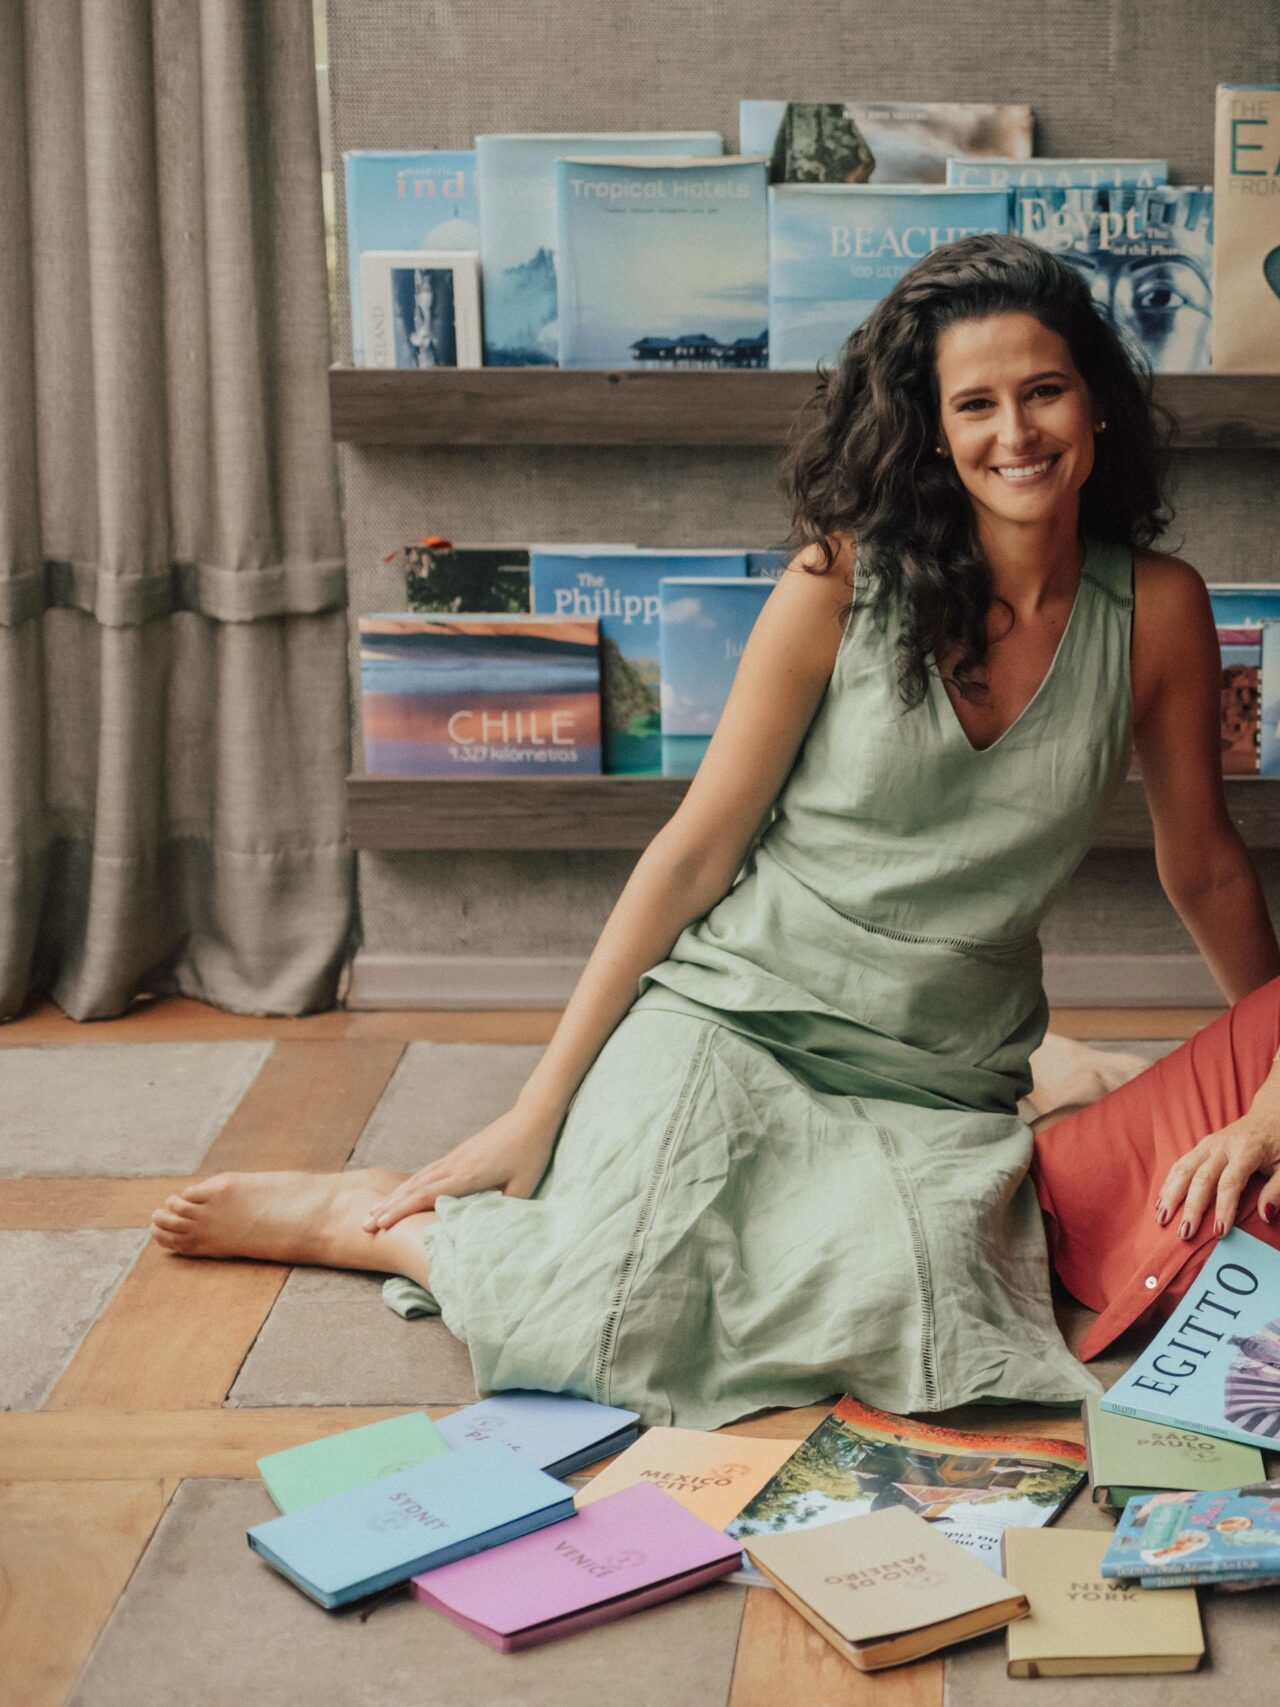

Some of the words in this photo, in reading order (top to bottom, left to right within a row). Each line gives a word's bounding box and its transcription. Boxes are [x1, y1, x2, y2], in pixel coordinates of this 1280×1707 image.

[1231, 99, 1271, 118] THE
[397, 170, 480, 200] indi
[959, 167, 1154, 188] CROATIA
[569, 179, 665, 201] Tropical
[672, 179, 749, 199] Hotels
[1020, 197, 1141, 251] Egypt
[831, 225, 1000, 258] BEACH
[372, 306, 387, 367] CELAND
[577, 572, 606, 588] The
[554, 589, 661, 625] Philipp
[447, 710, 577, 745] CHILE
[1130, 1262, 1259, 1397] EGITTO
[1137, 1439, 1216, 1450] PAULO
[1151, 1431, 1200, 1442] SÃO
[639, 1469, 733, 1487] MEXICO
[655, 1480, 704, 1493] CITY
[388, 1492, 450, 1531] SYDNEY
[555, 1540, 613, 1577] VENICE
[823, 1553, 928, 1585] JANEIRO
[882, 1564, 927, 1581] RIO
[847, 1577, 877, 1590] DE
[1071, 1583, 1131, 1592] NEW
[1065, 1592, 1138, 1603] YORK
